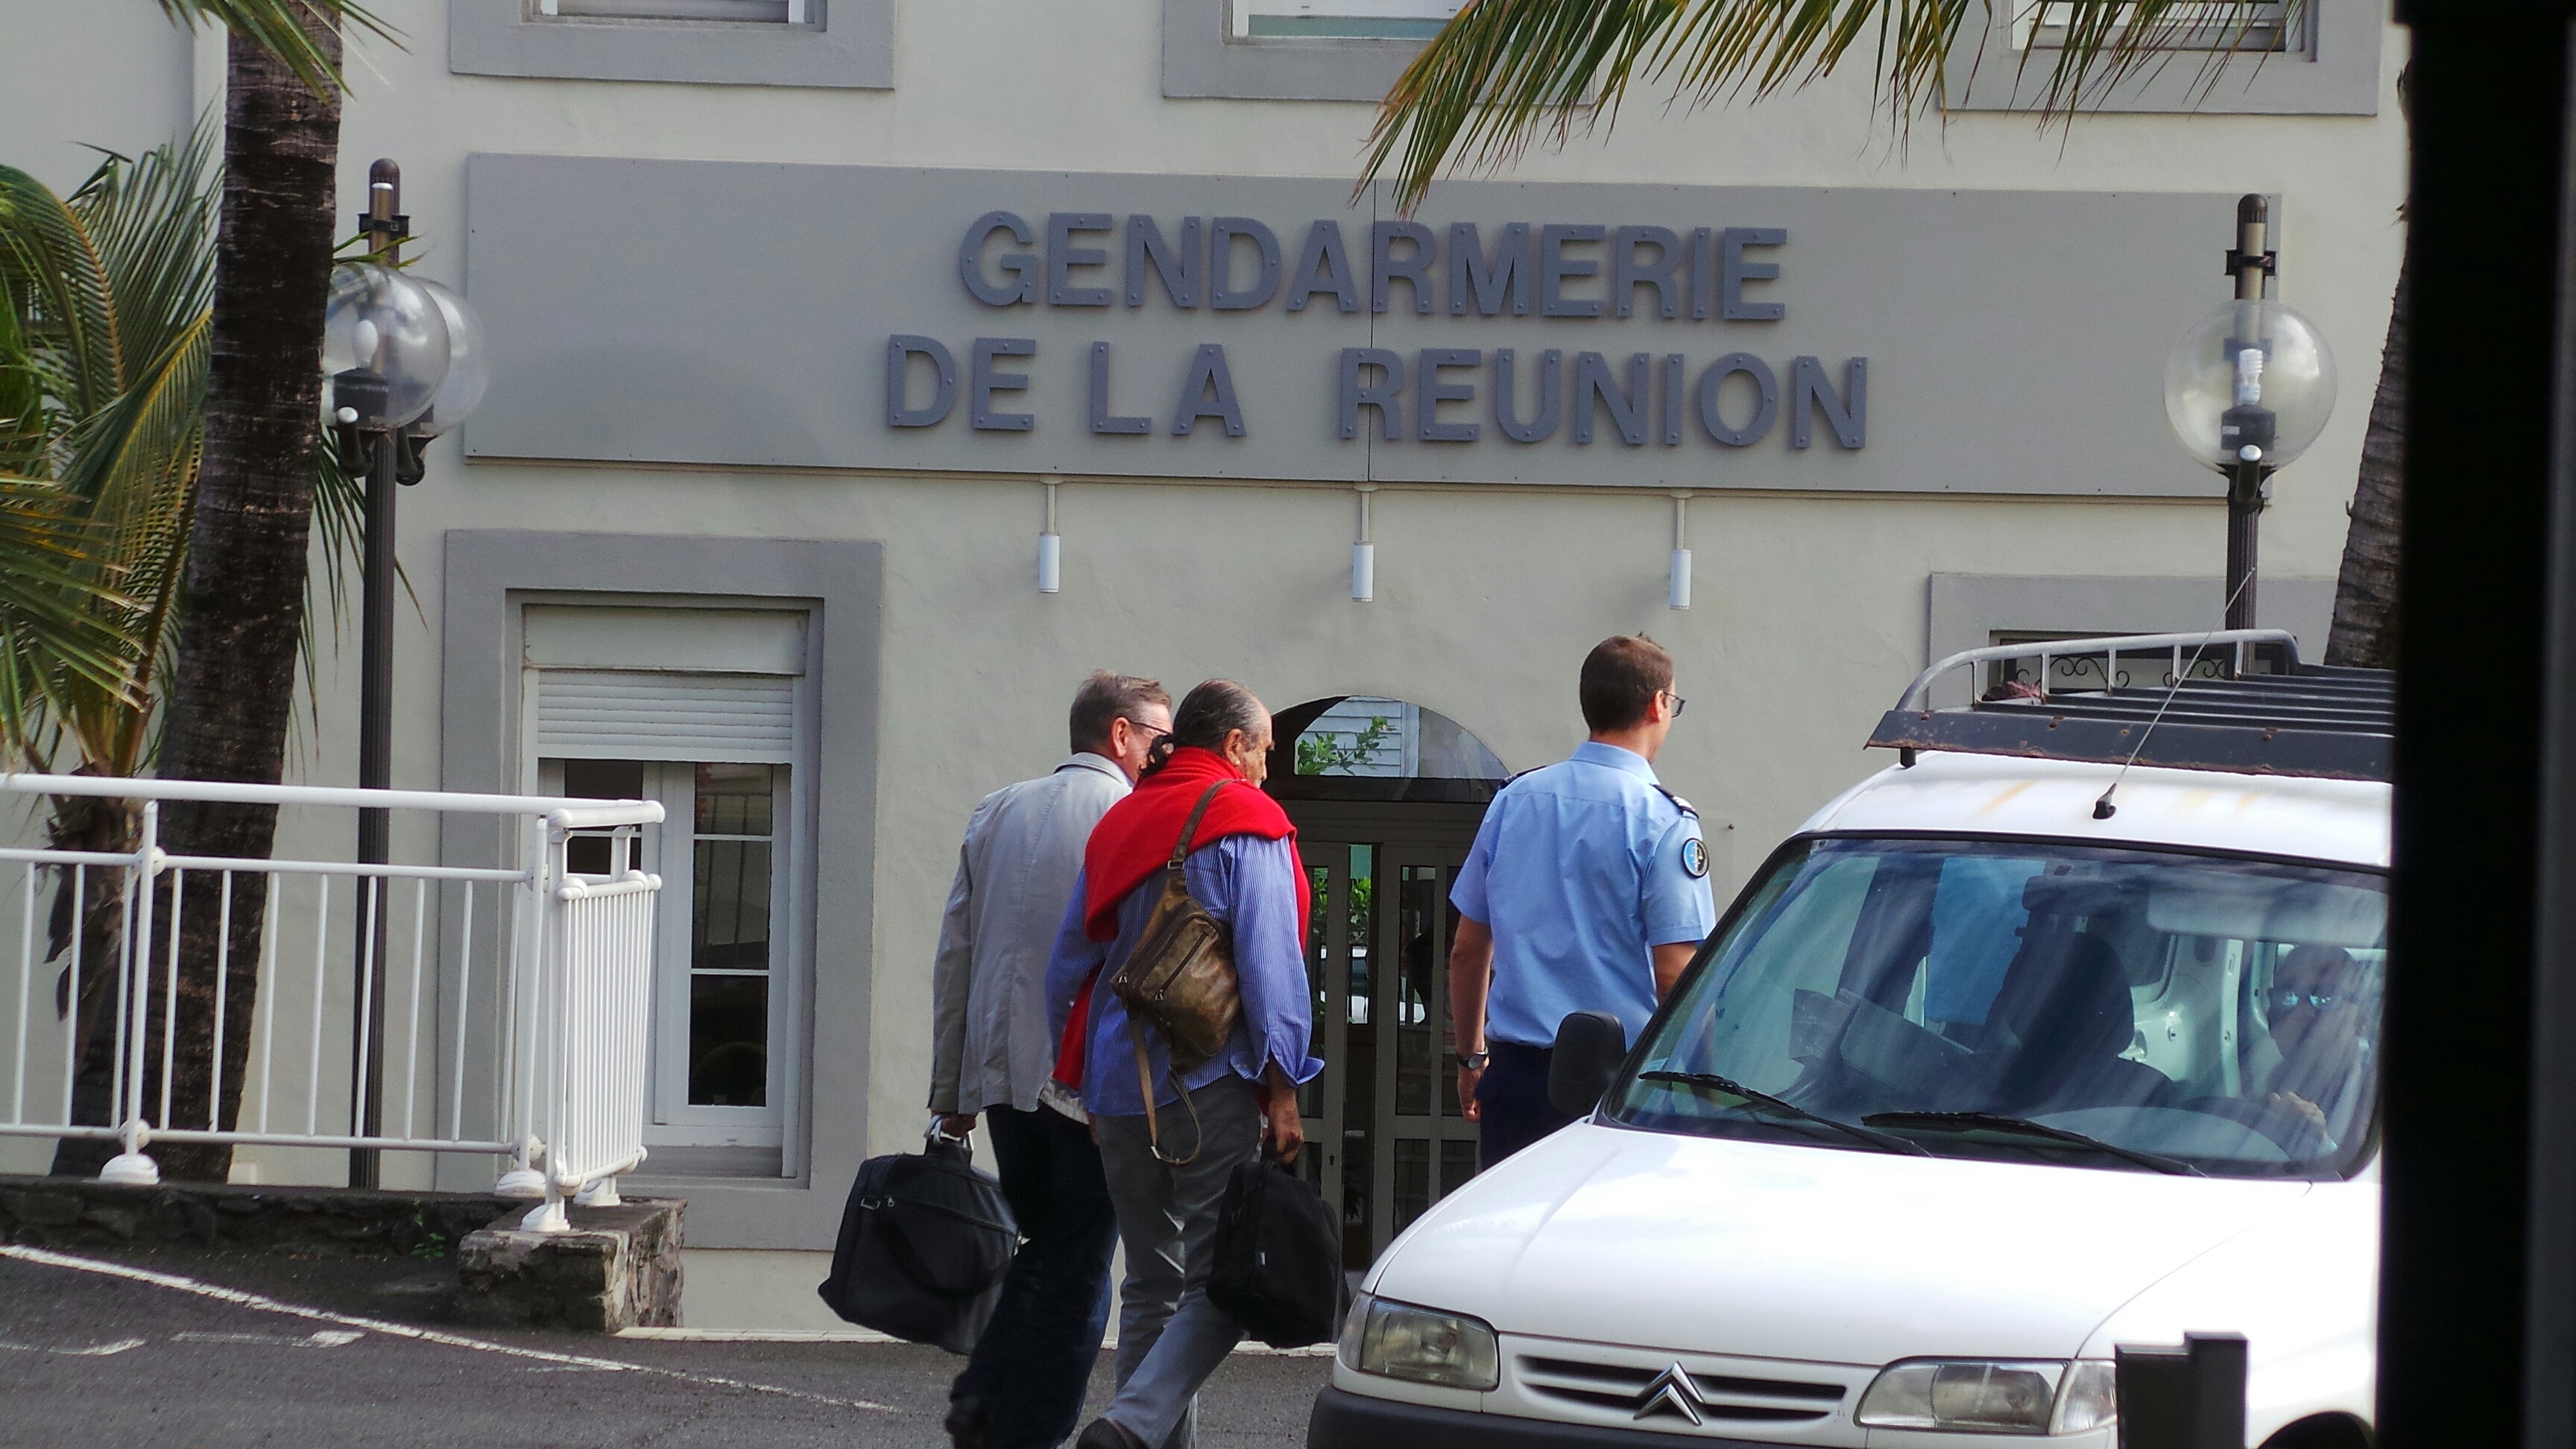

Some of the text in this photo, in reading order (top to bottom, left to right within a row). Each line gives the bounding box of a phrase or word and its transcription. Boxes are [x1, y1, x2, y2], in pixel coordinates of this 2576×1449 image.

[959, 210, 1787, 321] GENDARMERIE
[888, 333, 1868, 449] DE LA REUNION
